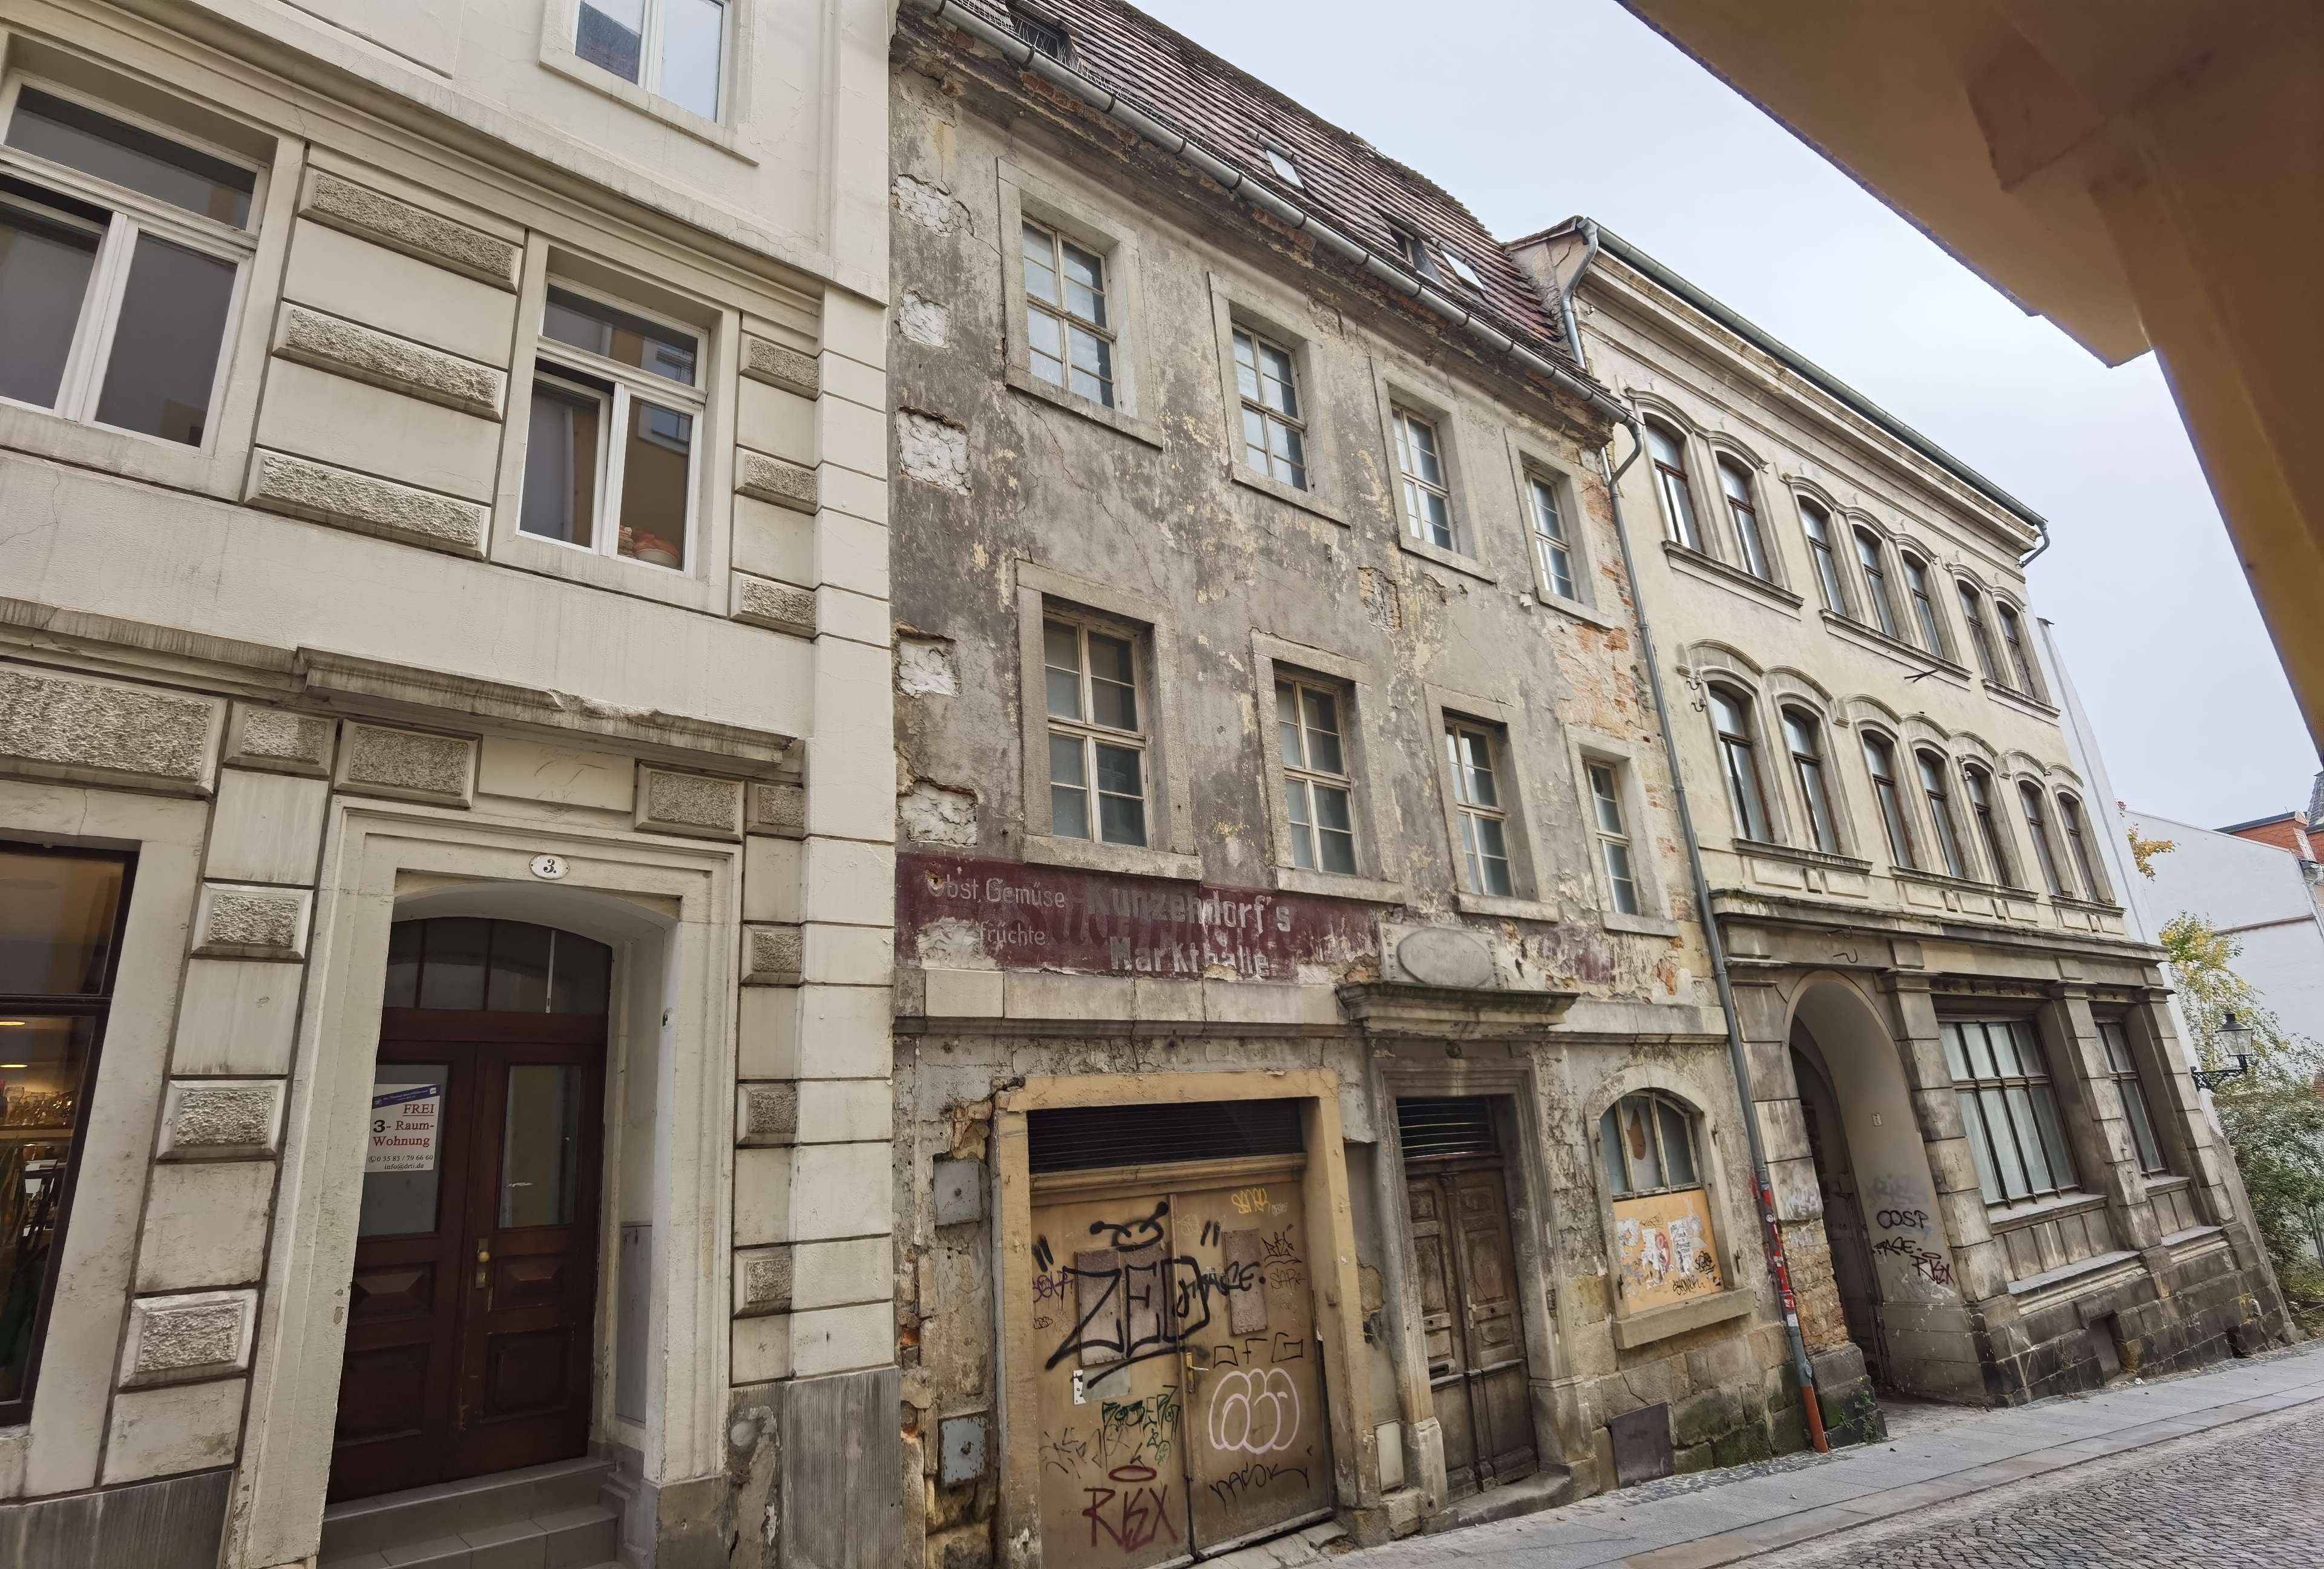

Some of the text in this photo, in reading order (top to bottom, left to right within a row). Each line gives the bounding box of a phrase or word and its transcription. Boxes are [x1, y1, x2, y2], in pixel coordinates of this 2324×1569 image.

[985, 877, 1066, 909] Gemüse
[402, 1104, 435, 1114] FREI
[372, 1136, 431, 1148] Wohnung
